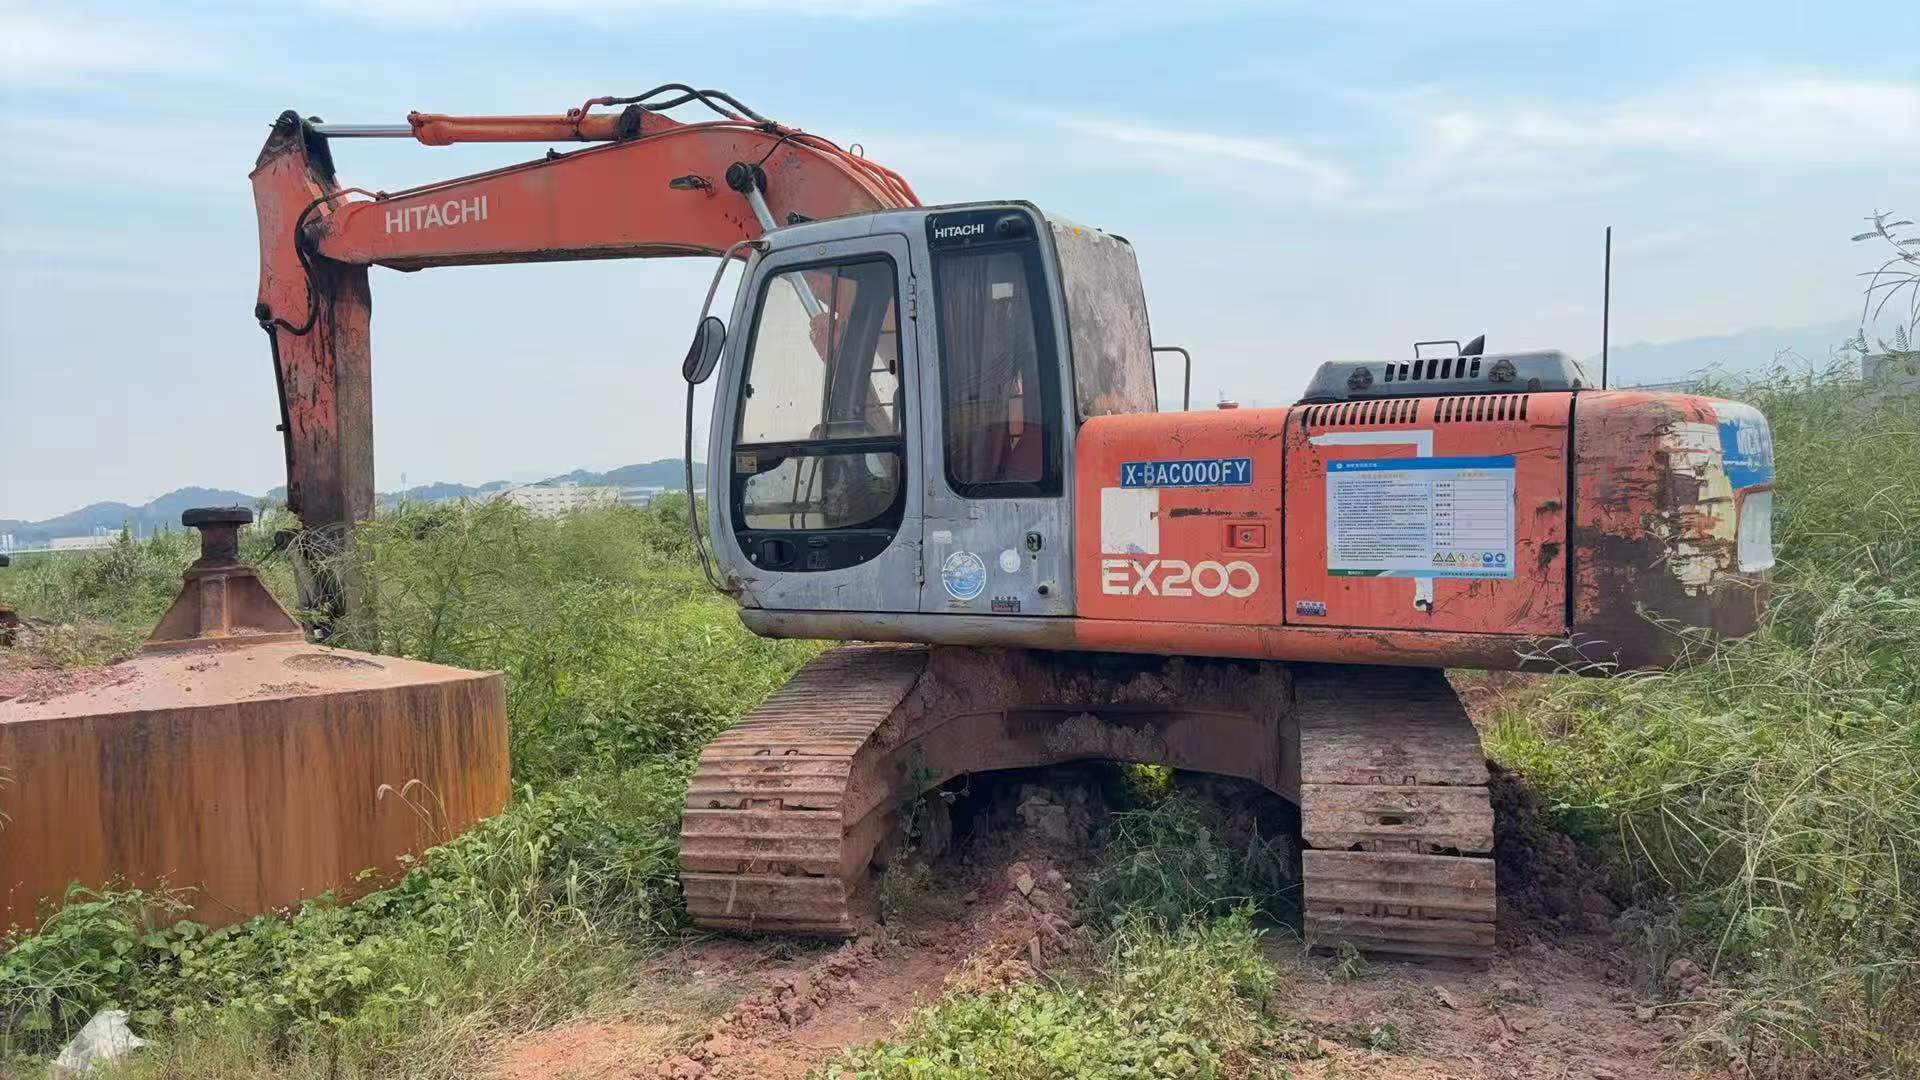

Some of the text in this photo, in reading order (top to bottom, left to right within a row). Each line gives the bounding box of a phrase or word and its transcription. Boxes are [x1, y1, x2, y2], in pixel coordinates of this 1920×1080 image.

[385, 195, 488, 234] HITACHI
[934, 223, 985, 239] HITACHI
[1101, 559, 1260, 598] EX200
